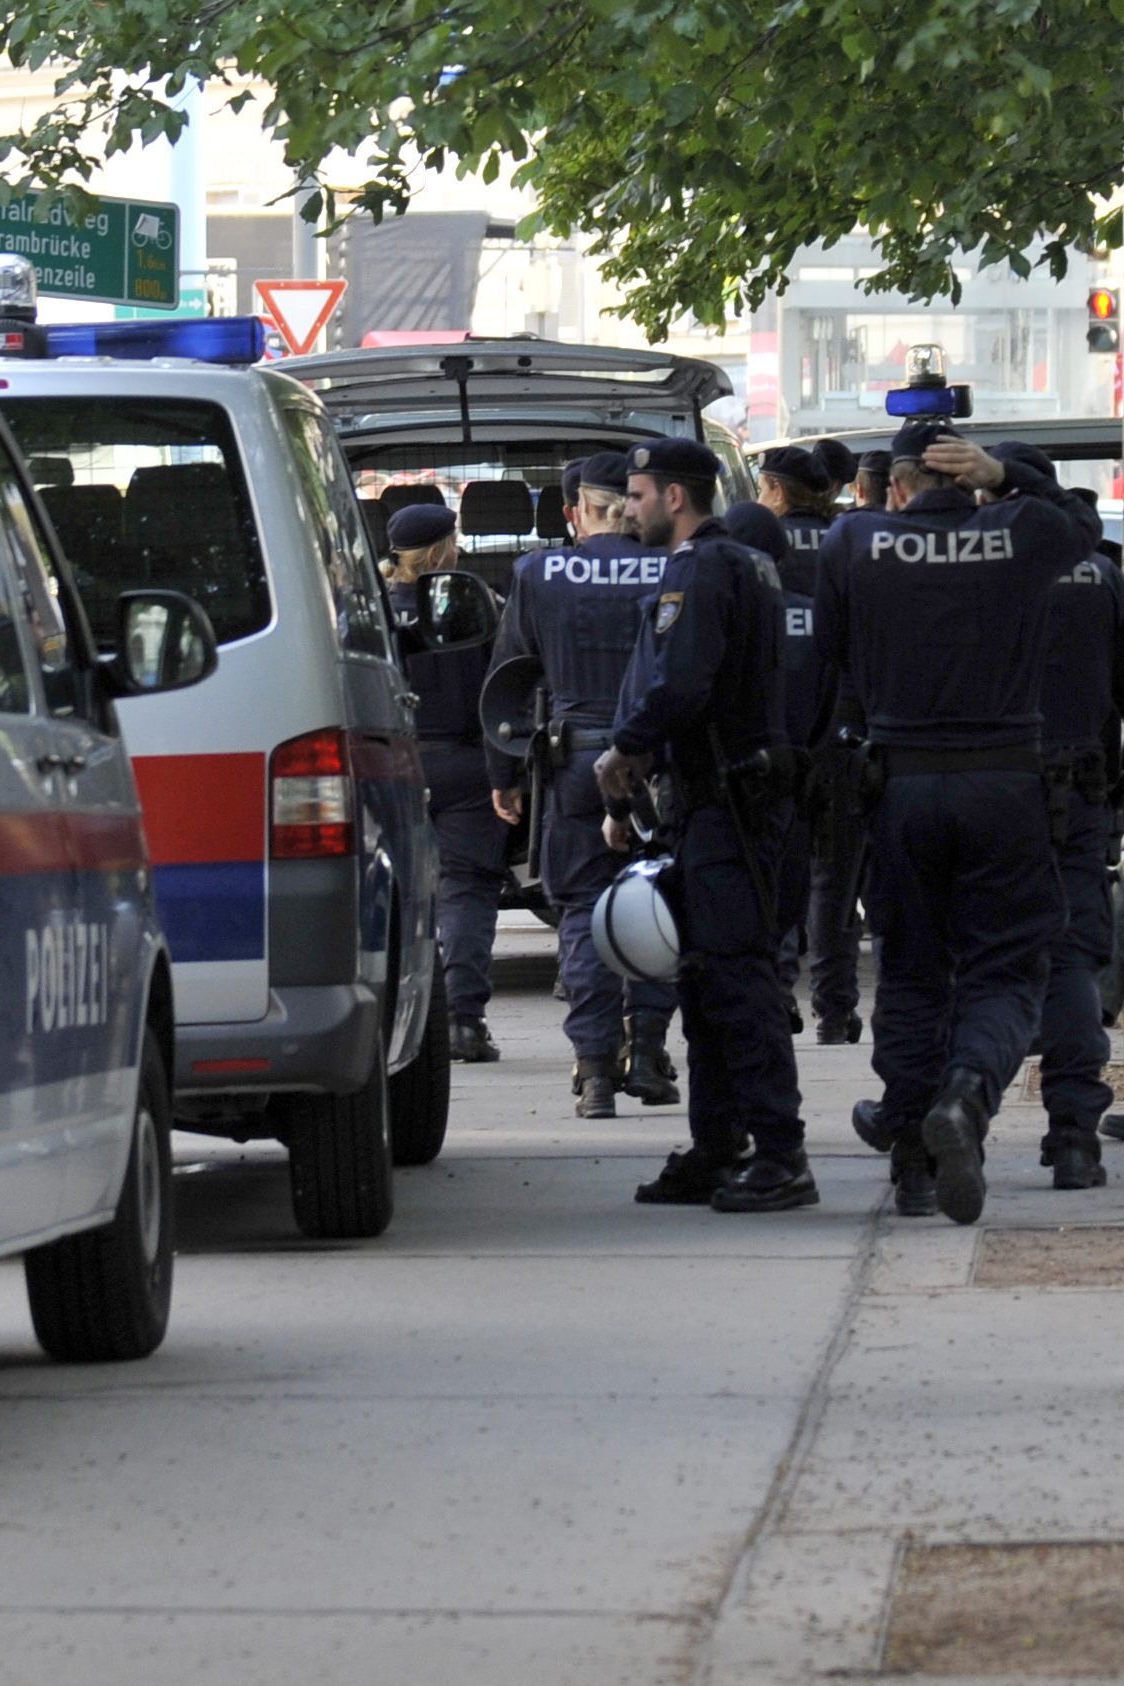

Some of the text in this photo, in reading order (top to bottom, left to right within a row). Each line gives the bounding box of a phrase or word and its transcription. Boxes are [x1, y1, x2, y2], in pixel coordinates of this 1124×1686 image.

[36, 265, 96, 289] enzeile
[871, 528, 1014, 563] POLIZEI
[1057, 561, 1102, 585] EI
[25, 922, 108, 1034] POLIZEI
